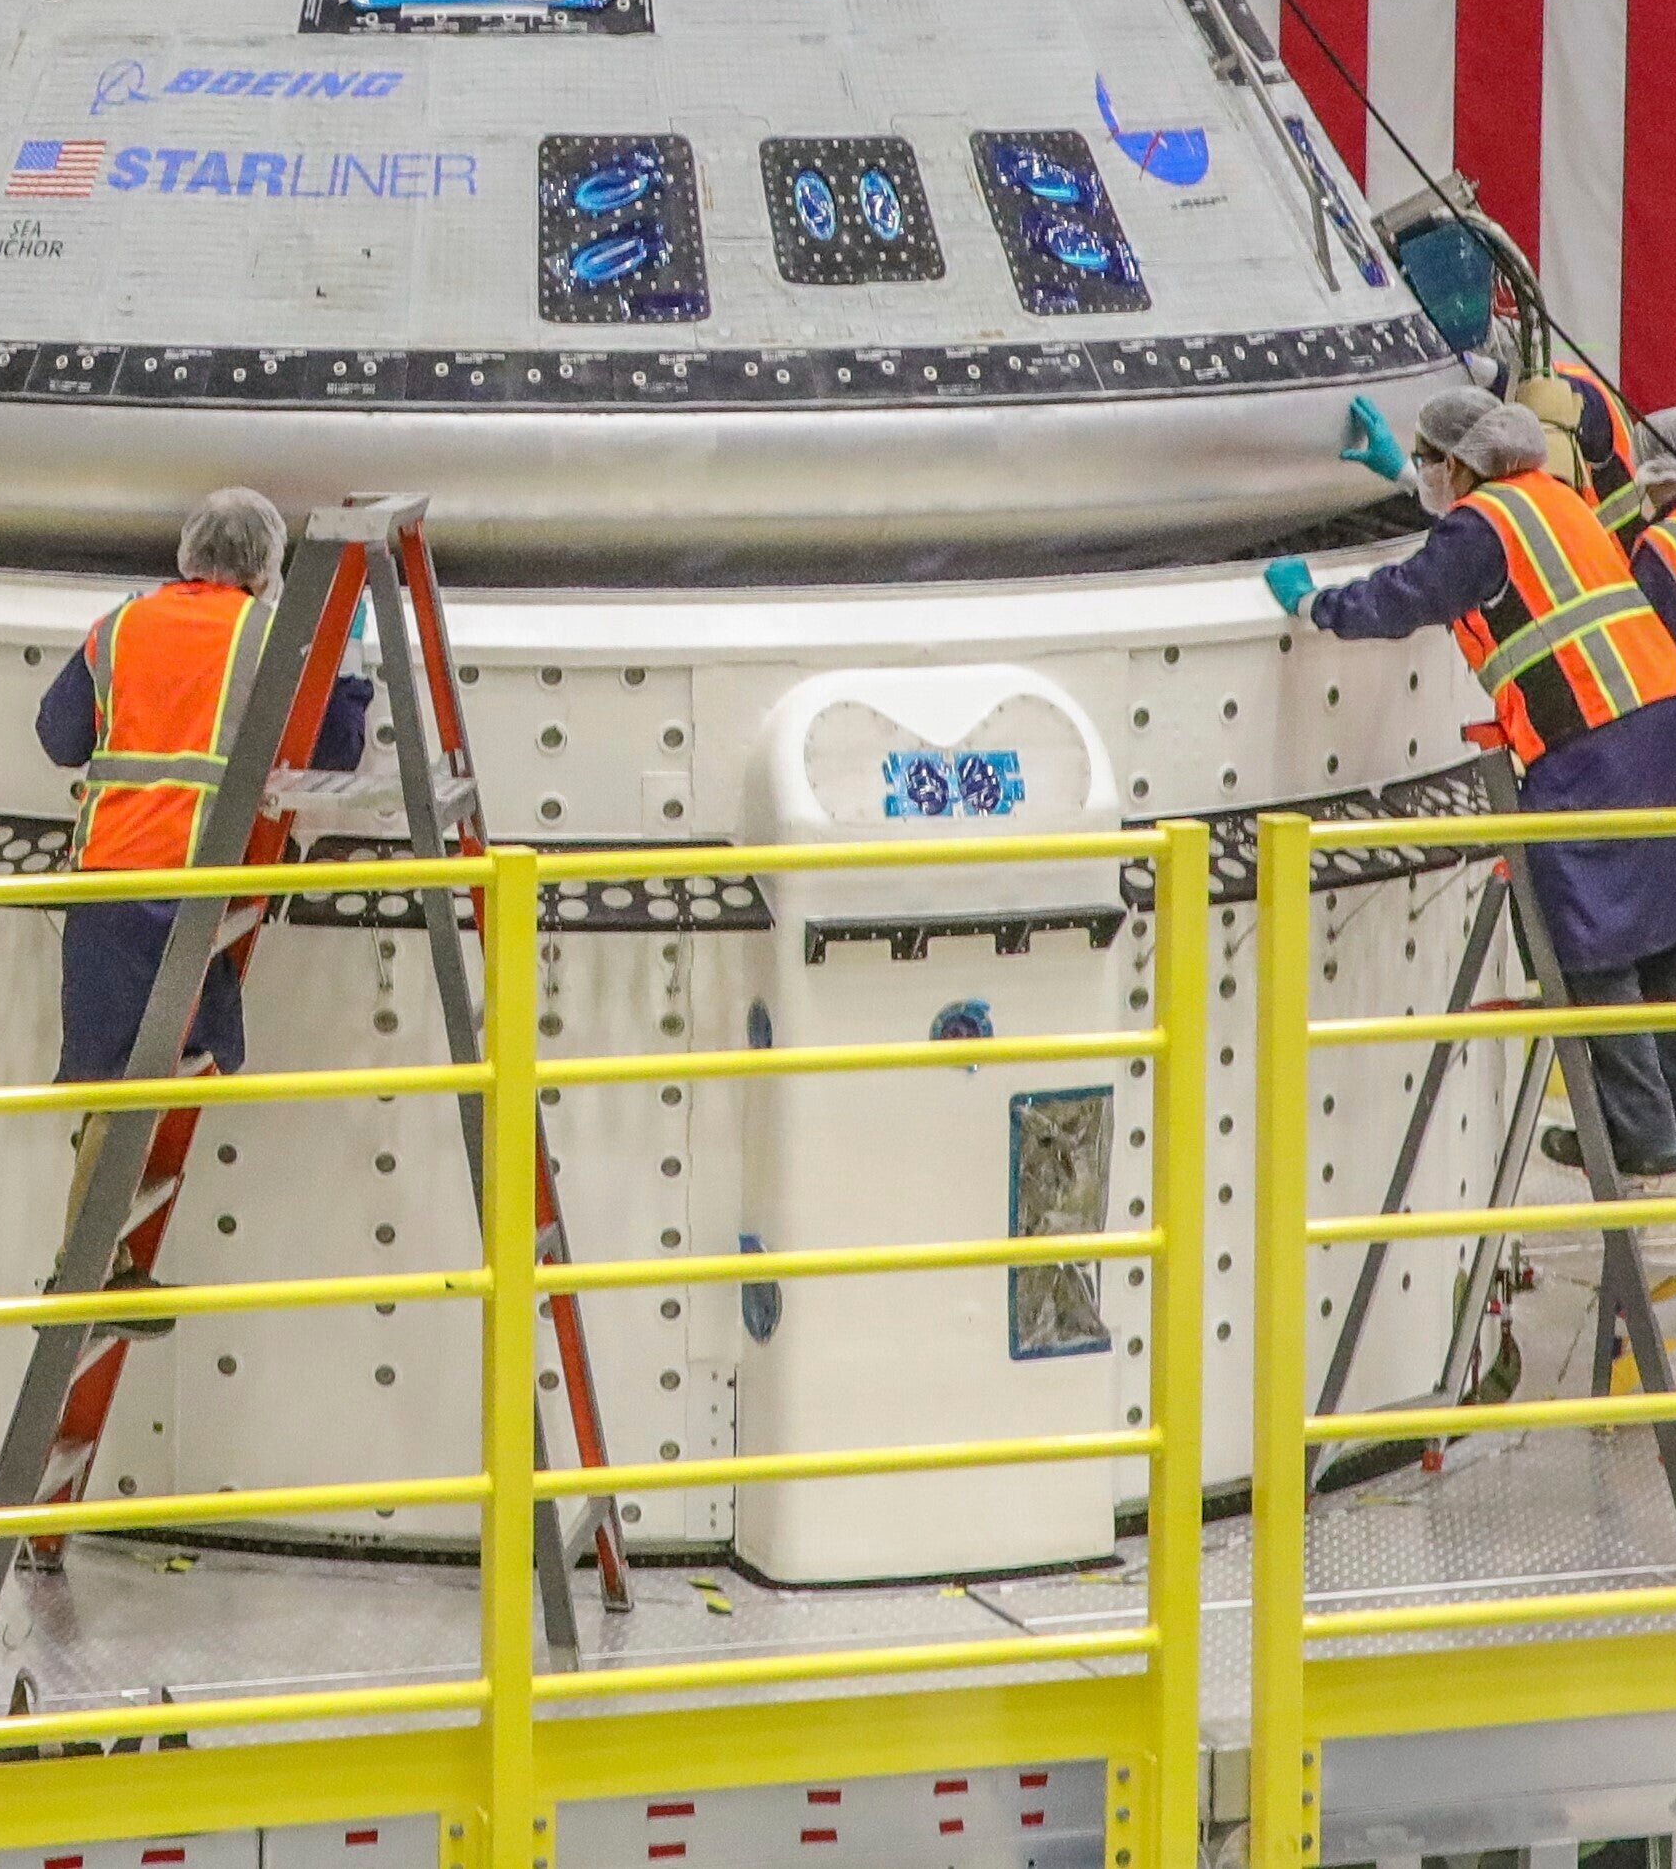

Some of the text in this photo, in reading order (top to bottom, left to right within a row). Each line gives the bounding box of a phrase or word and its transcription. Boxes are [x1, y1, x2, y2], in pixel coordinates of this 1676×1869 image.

[163, 67, 405, 98] BOEING
[106, 146, 478, 199] STARLINER
[9, 219, 41, 241] SEA
